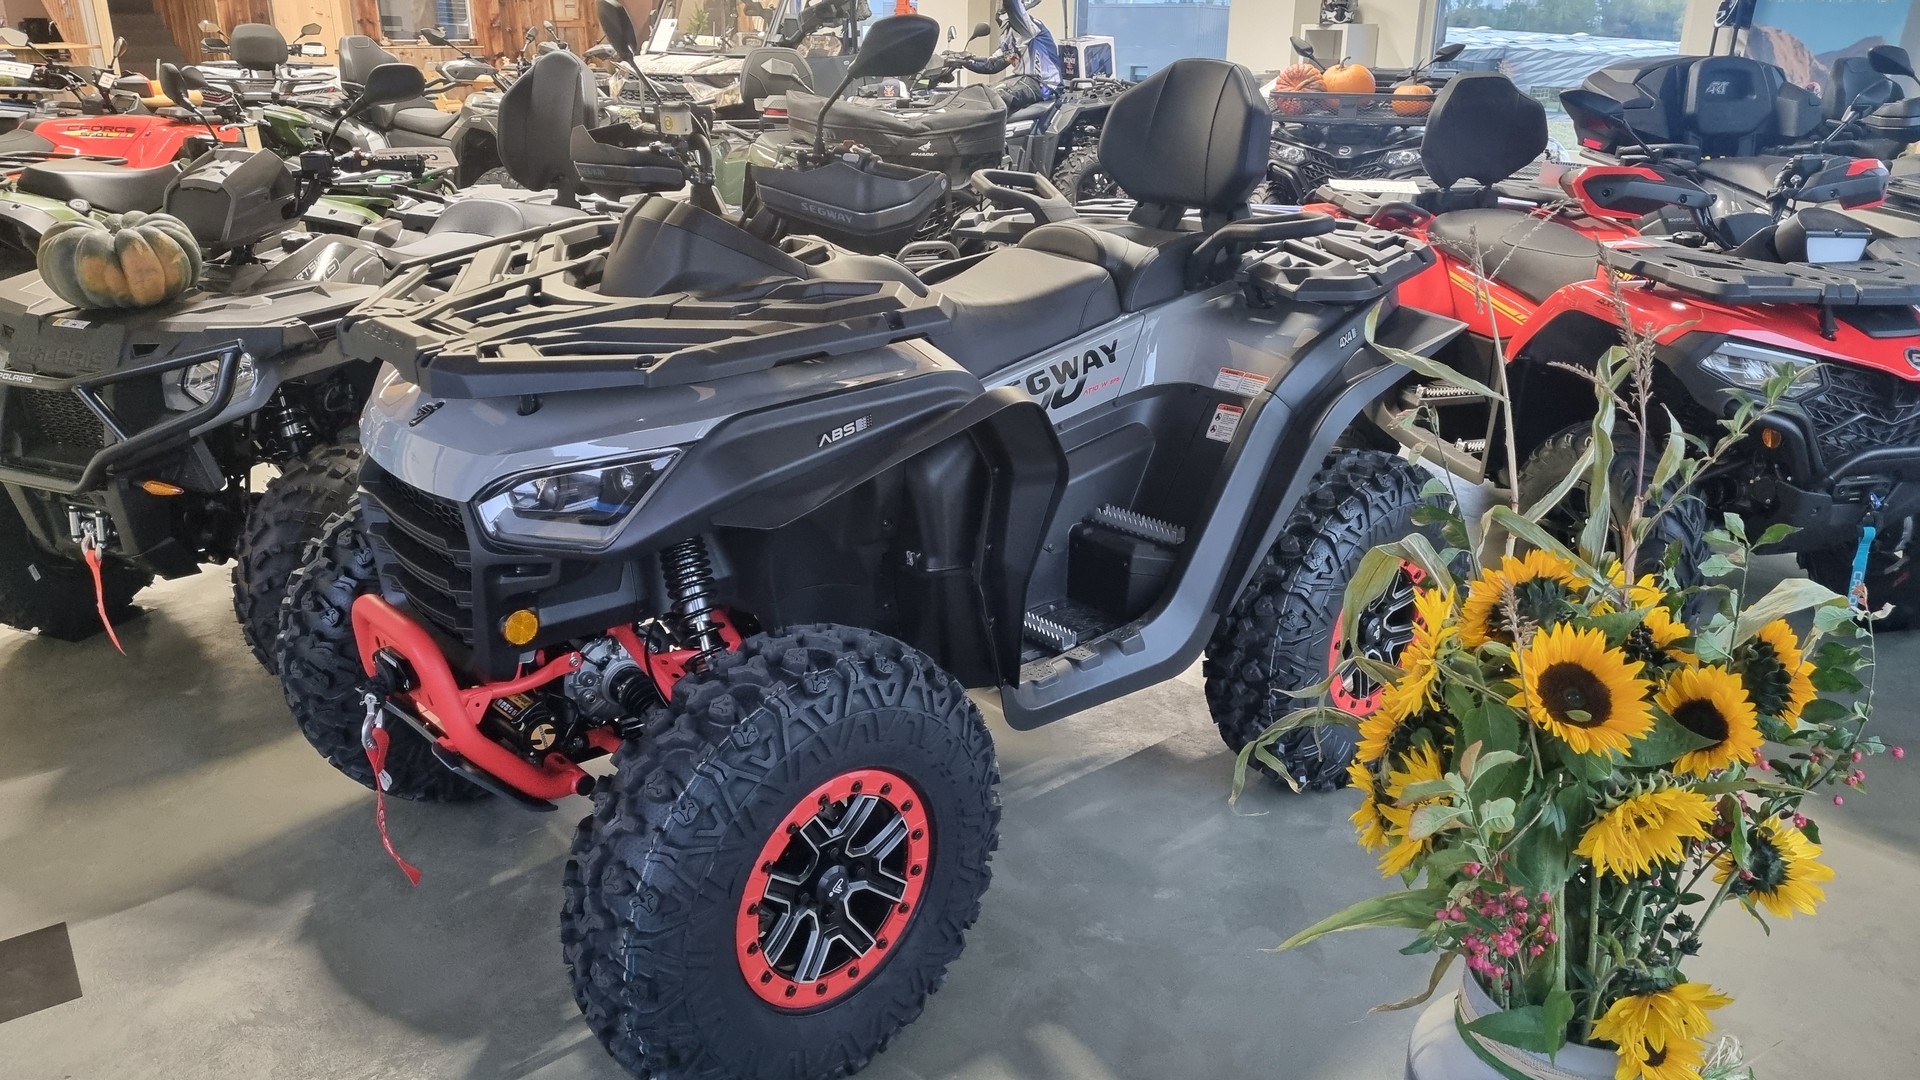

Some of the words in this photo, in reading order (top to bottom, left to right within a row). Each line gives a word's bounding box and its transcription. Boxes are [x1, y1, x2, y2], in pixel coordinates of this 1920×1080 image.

[67, 125, 137, 133] CFORCE
[801, 202, 853, 224] SEGWAY
[1339, 330, 1353, 348] 4X4
[1005, 338, 1118, 396] GWAY
[818, 421, 856, 448] ABS
